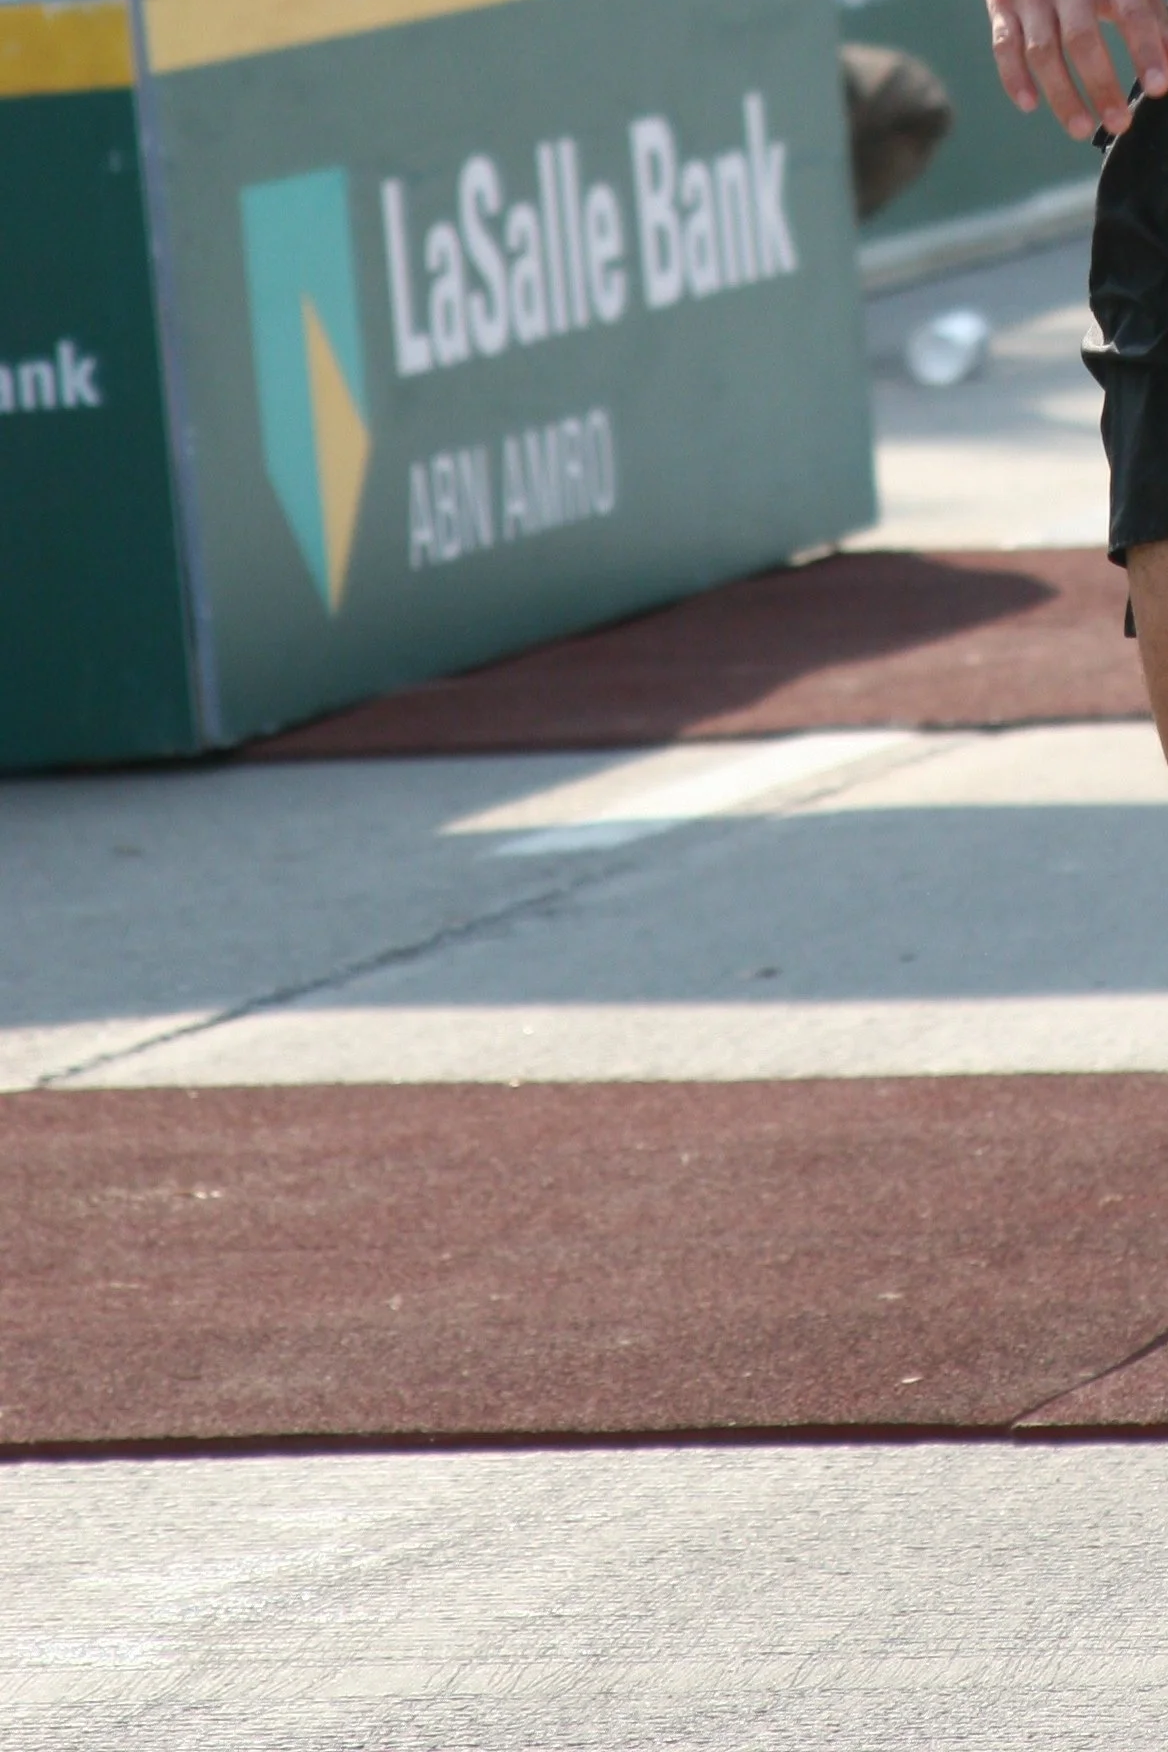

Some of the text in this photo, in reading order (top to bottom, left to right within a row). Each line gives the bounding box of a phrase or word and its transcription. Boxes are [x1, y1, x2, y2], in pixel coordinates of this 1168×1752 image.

[380, 92, 798, 378] LaSalle Bank
[408, 406, 616, 571] ABN AMRO
